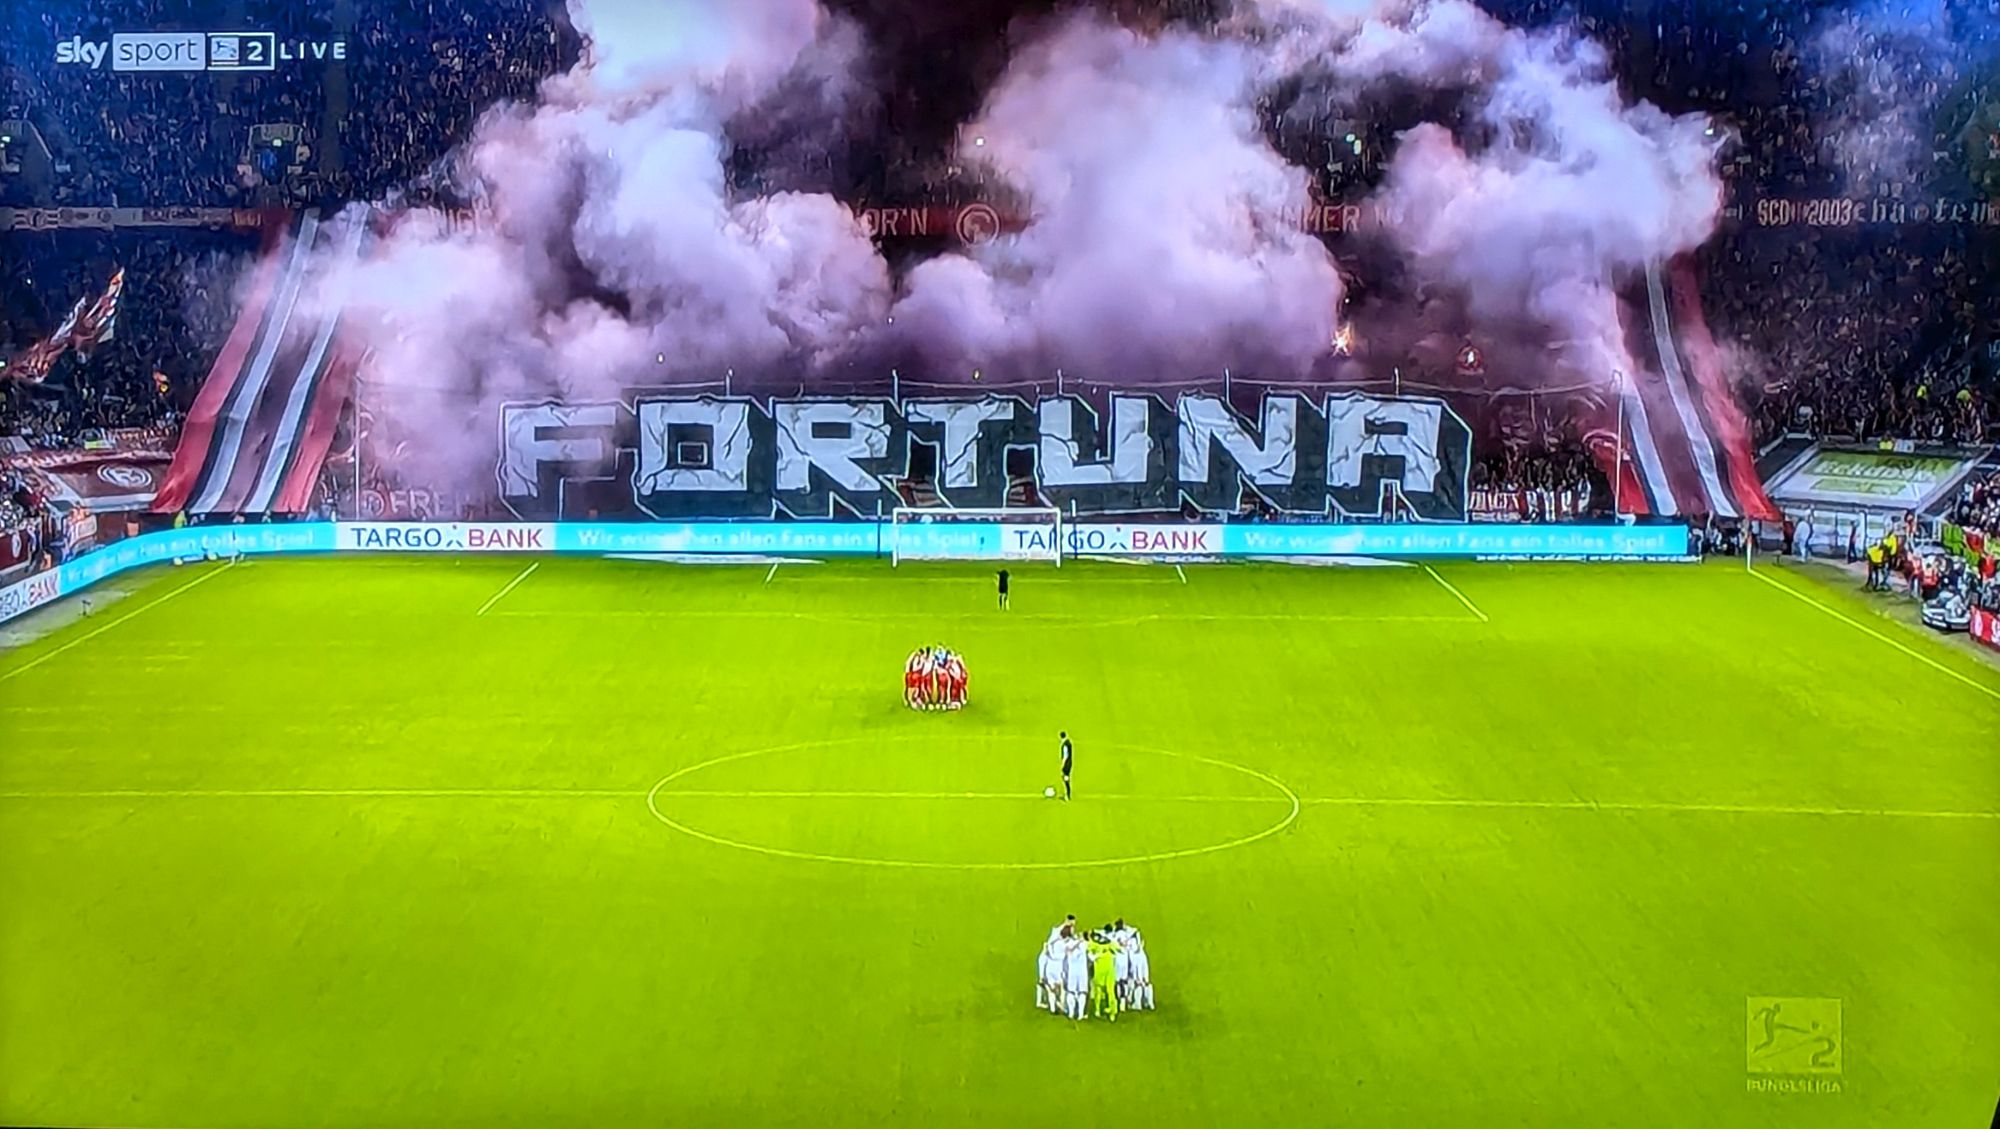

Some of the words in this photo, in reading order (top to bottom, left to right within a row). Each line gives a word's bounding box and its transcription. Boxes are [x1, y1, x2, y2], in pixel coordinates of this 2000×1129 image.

[1807, 199, 1853, 226] 2003
[499, 393, 1470, 522] FORTUNA
[468, 528, 543, 548] BANK
[577, 528, 614, 546] Wir
[729, 529, 773, 547] allen
[781, 529, 827, 547] Fans
[1132, 530, 1208, 551] BANK
[1244, 531, 1283, 547] Wir
[1402, 531, 1450, 549] allen
[1457, 532, 1504, 548] Fans
[1510, 533, 1543, 548] ein
[1549, 532, 1604, 549] tolles
